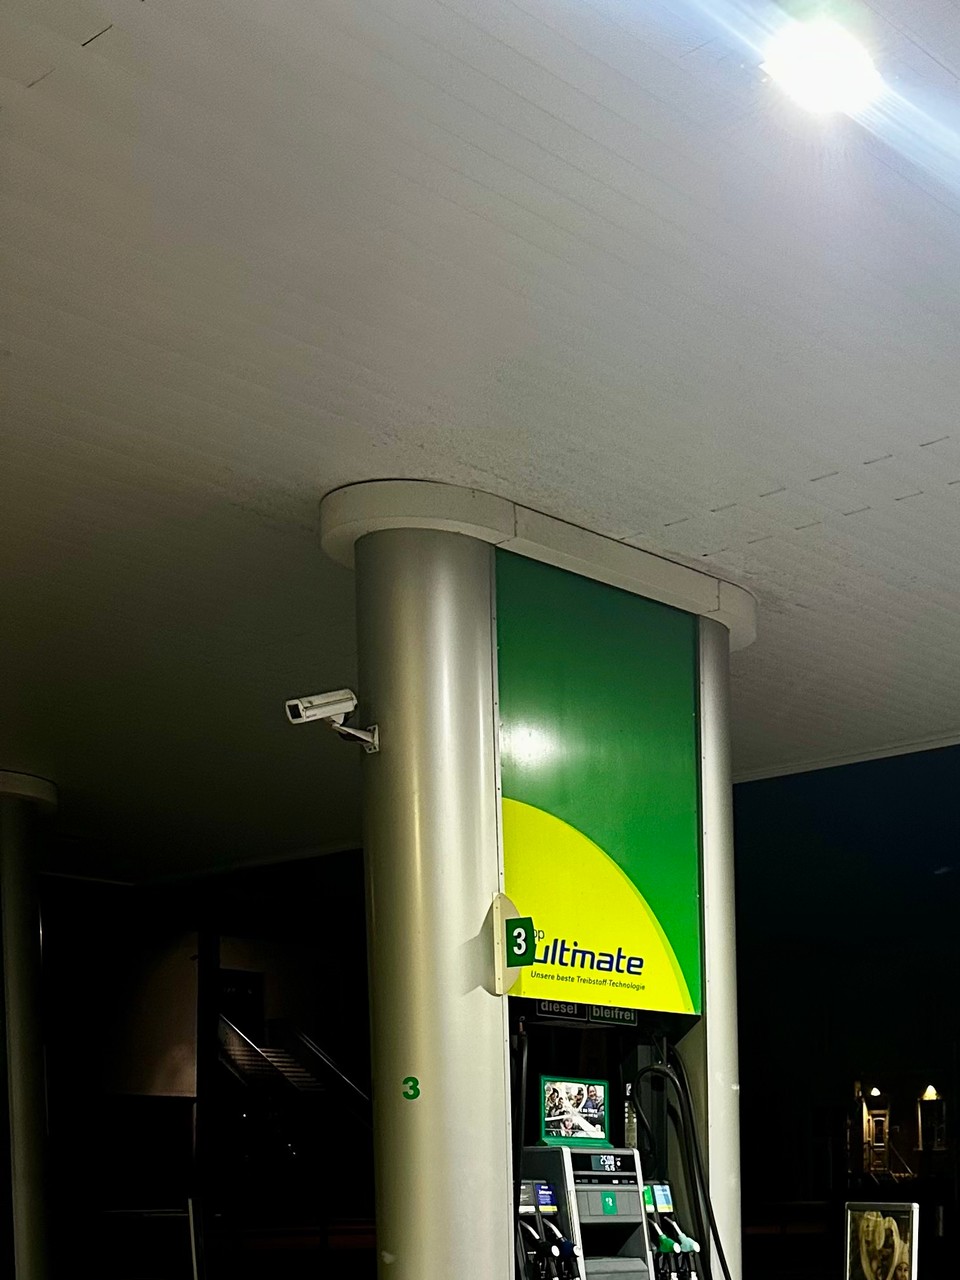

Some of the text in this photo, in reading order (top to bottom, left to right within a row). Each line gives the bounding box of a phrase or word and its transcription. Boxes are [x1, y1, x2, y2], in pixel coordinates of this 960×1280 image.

[512, 927, 527, 955] 3
[533, 938, 645, 976] ultimate
[530, 970, 646, 991] Unsere beste Treibstoff-Technologie
[540, 1000, 578, 1015] diesel
[592, 1005, 636, 1021] bleifrei
[402, 1076, 421, 1100] 3
